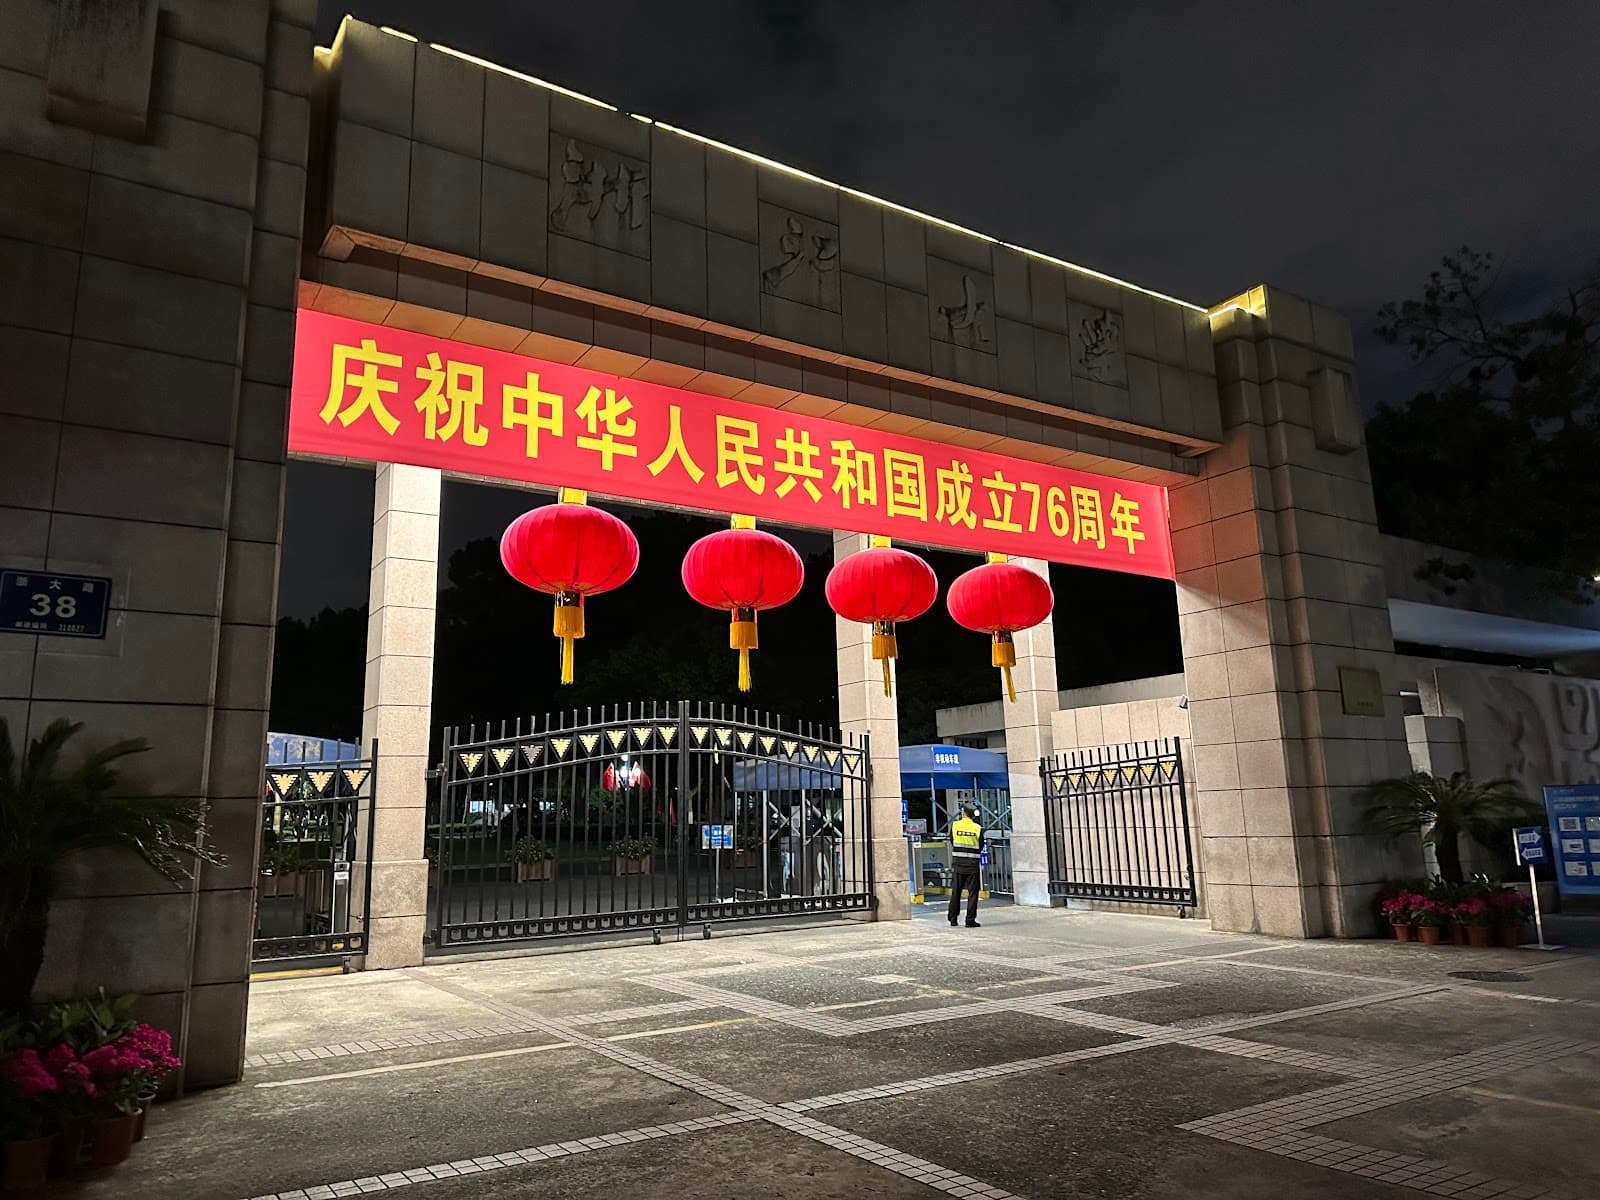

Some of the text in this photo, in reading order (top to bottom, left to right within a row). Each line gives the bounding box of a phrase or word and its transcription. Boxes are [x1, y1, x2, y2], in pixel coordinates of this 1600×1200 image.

[319, 339, 1146, 555] 庆祝中华人民共和国成立76周年
[30, 593, 76, 618] 38
